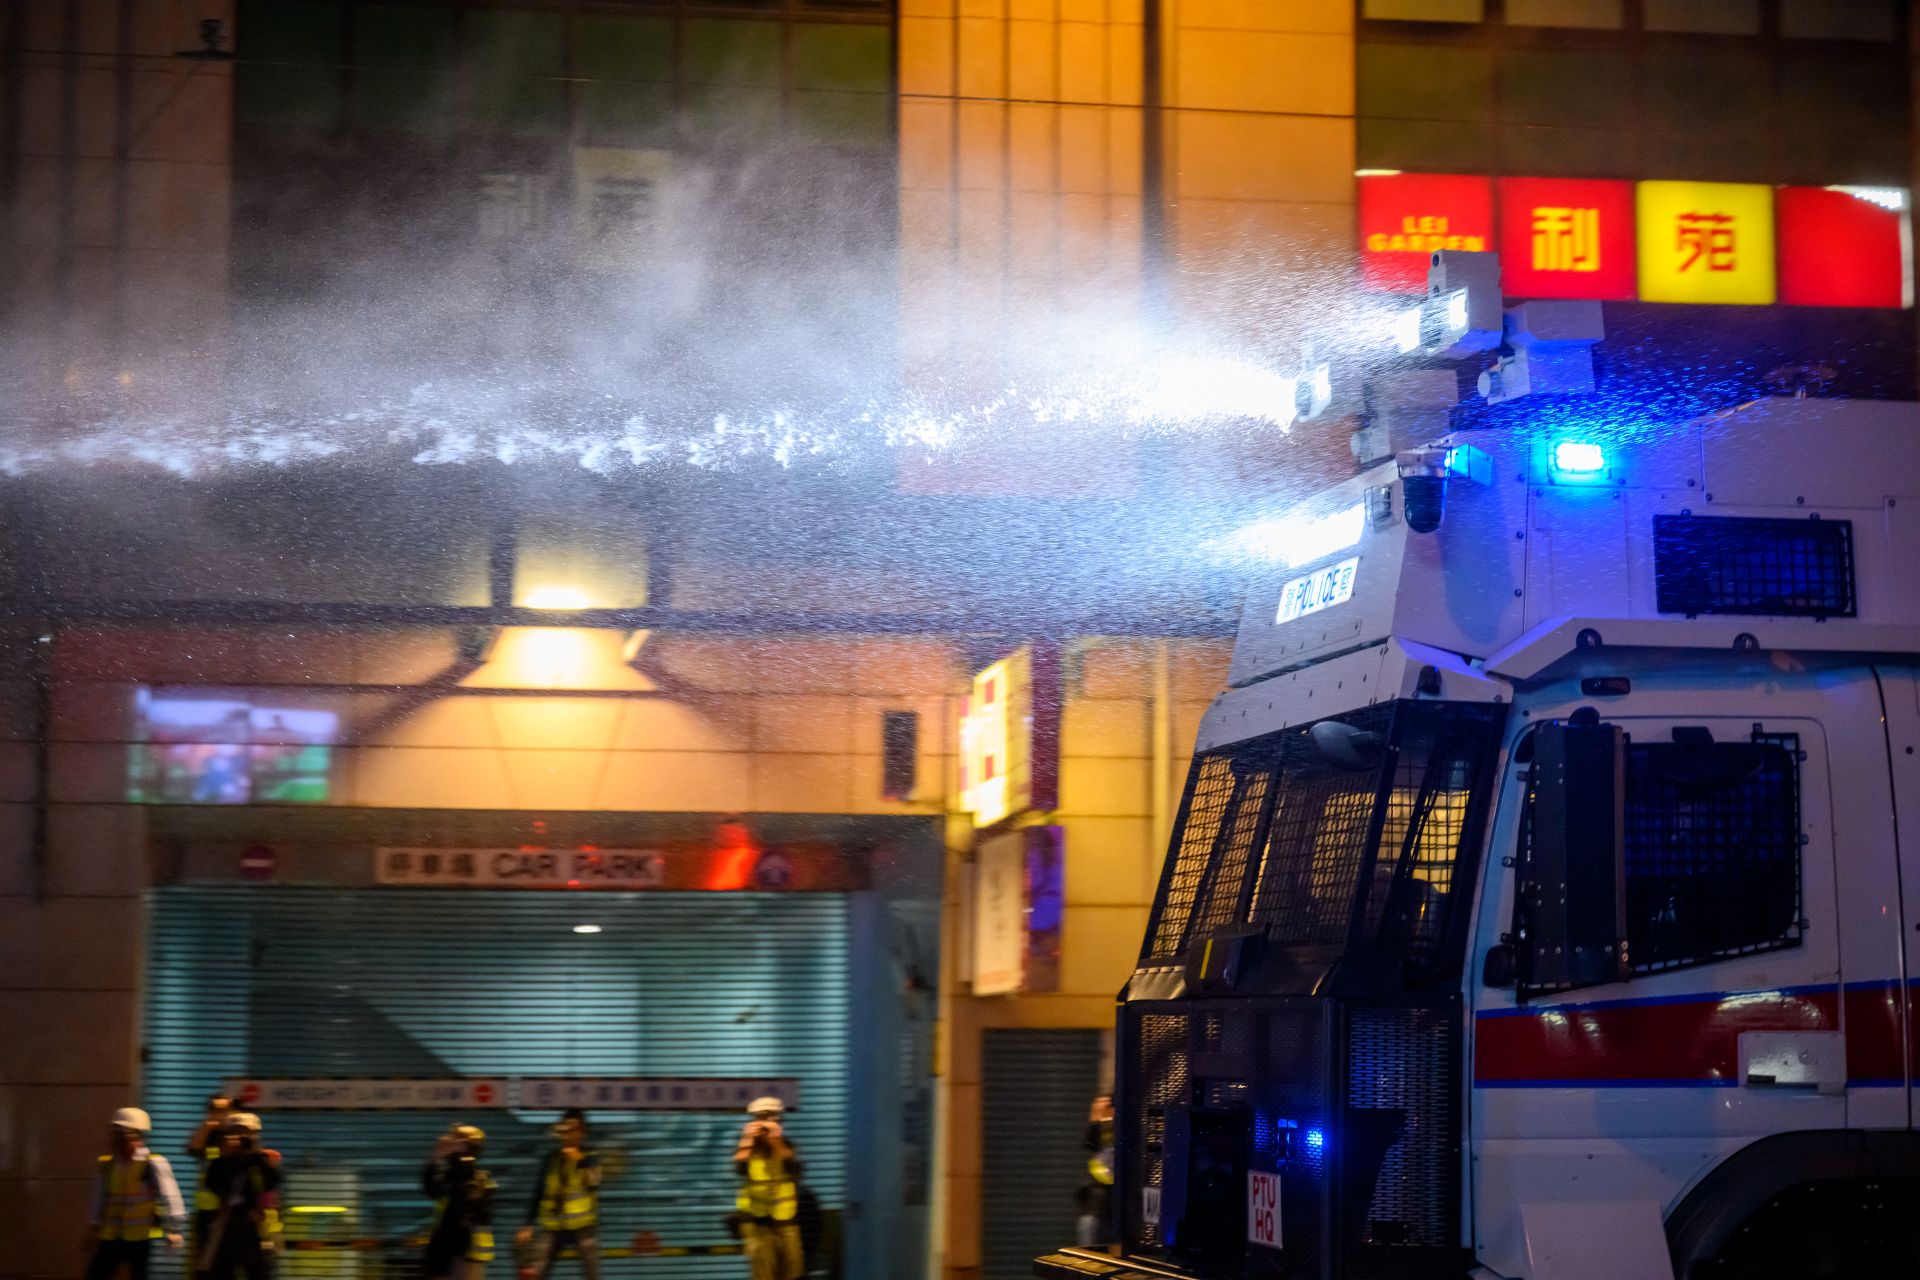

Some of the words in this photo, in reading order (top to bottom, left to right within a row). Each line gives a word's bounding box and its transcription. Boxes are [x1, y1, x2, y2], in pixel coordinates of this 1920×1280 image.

[1403, 216, 1447, 233] LEI
[1531, 206, 1736, 272] 利苑
[1367, 233, 1485, 252] GARDEN
[1294, 568, 1341, 613] POLICE
[1252, 1175, 1276, 1208] PTU
[1255, 1210, 1274, 1243] HQ
